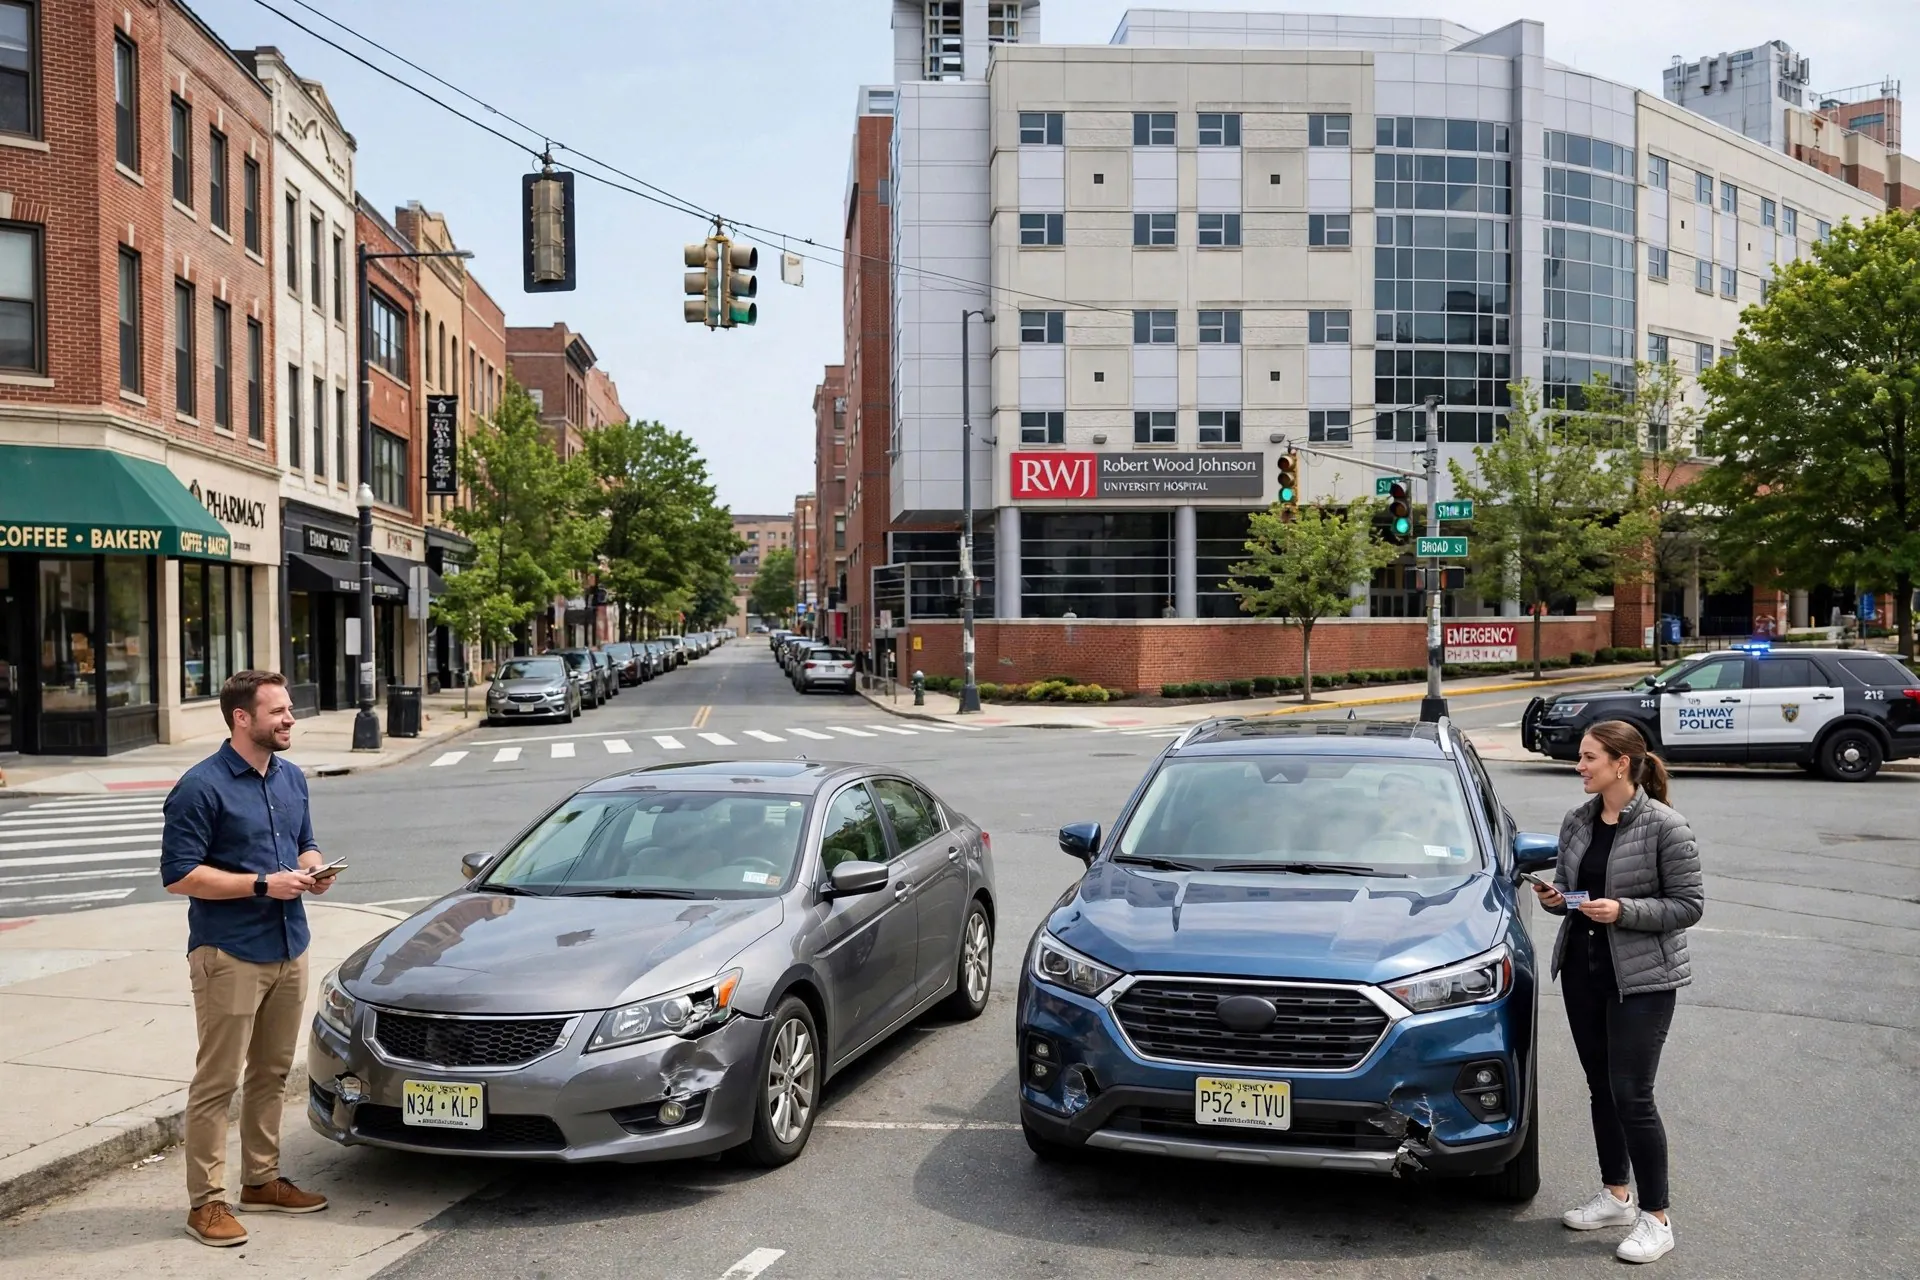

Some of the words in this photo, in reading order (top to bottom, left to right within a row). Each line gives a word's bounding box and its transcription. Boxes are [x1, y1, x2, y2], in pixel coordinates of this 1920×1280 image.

[1103, 457, 1148, 472] Robert
[1152, 458, 1194, 472] Wood
[1195, 457, 1256, 474] Johnson
[1019, 460, 1091, 496] RWJ
[1104, 482, 1159, 491] UNIVERSITY
[1164, 482, 1208, 491] HOSPITAL
[206, 489, 266, 530] PHARMACY
[0, 525, 67, 547] COFFEE
[91, 528, 162, 549] BAKERY
[1421, 540, 1449, 553] BROAD
[1447, 627, 1514, 644] EMERGENCY
[1679, 708, 1734, 717] RAHWAY
[1680, 719, 1734, 729] POLICE
[407, 1093, 433, 1117] N34
[452, 1096, 478, 1118] KLP
[1201, 1090, 1233, 1114] P52
[1252, 1094, 1284, 1118] TVU
